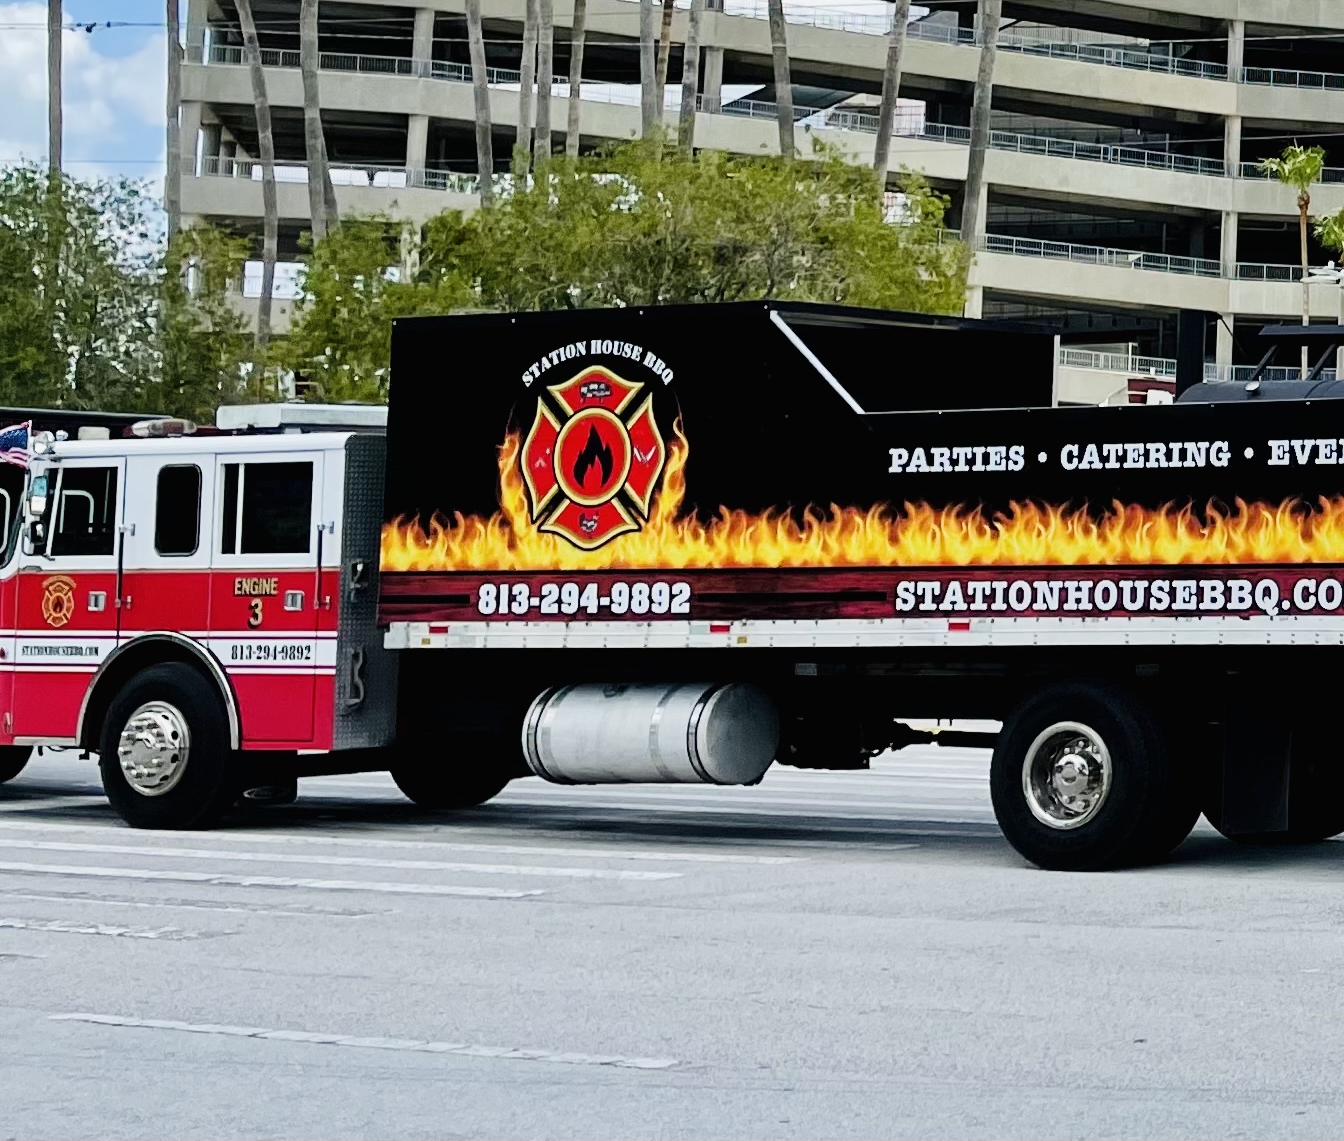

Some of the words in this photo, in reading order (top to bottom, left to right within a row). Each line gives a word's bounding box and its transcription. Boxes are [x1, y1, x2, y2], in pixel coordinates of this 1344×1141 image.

[522, 340, 587, 387] STATION
[590, 339, 643, 362] HOUSE
[889, 445, 1025, 473] PARTIES
[1060, 440, 1231, 470] CATERING
[234, 577, 279, 595] ENGINE
[478, 582, 691, 615] 813-294-9892
[249, 598, 263, 626] 3
[231, 644, 311, 661] 813-294-9892
